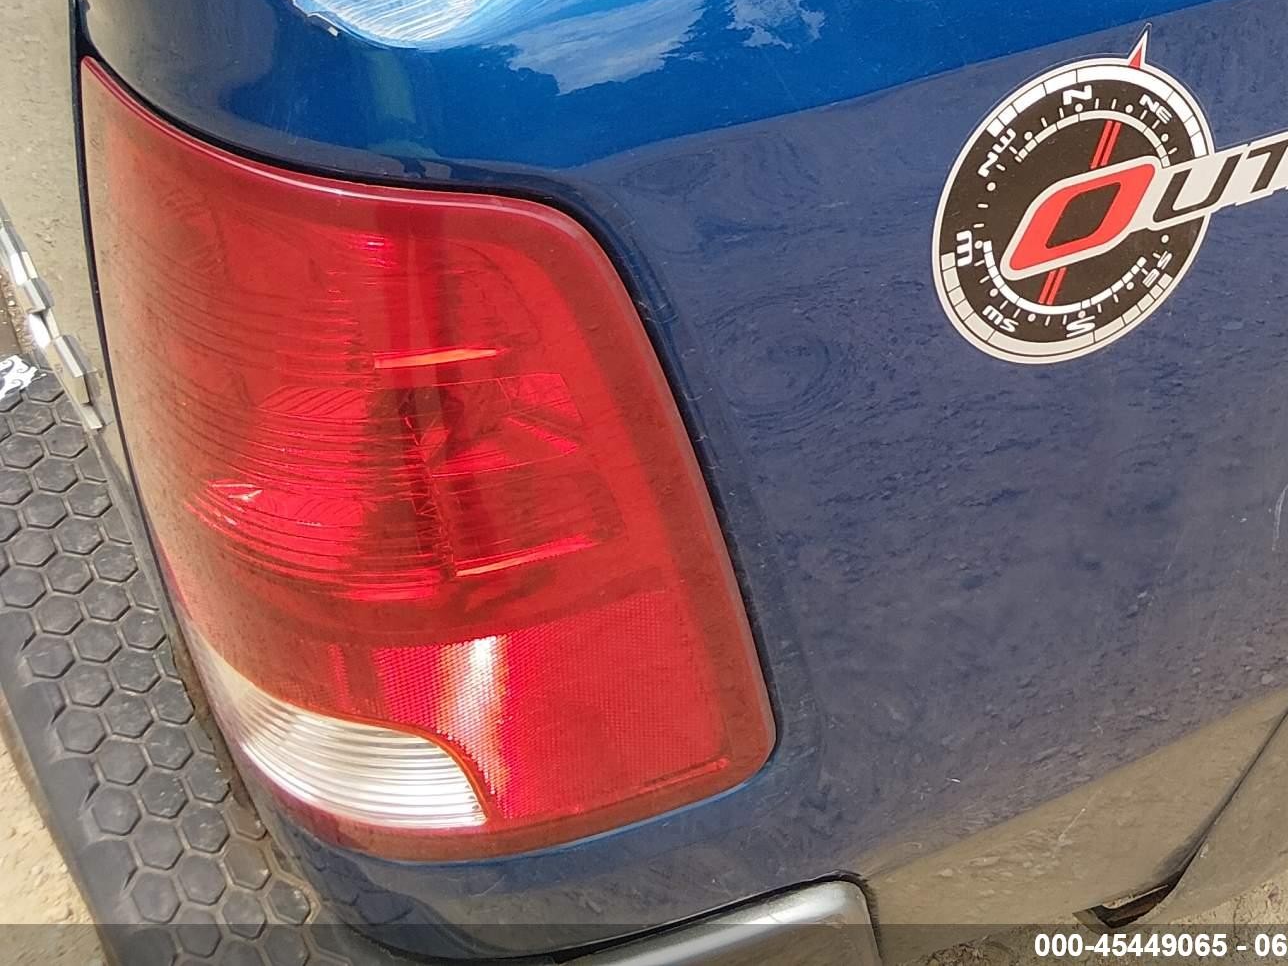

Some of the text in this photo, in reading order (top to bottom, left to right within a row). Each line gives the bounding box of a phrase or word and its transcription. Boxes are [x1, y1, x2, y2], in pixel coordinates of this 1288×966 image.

[1062, 84, 1092, 105] N
[1138, 94, 1174, 124] NE
[977, 127, 1016, 178] NW
[1065, 315, 1096, 338] S
